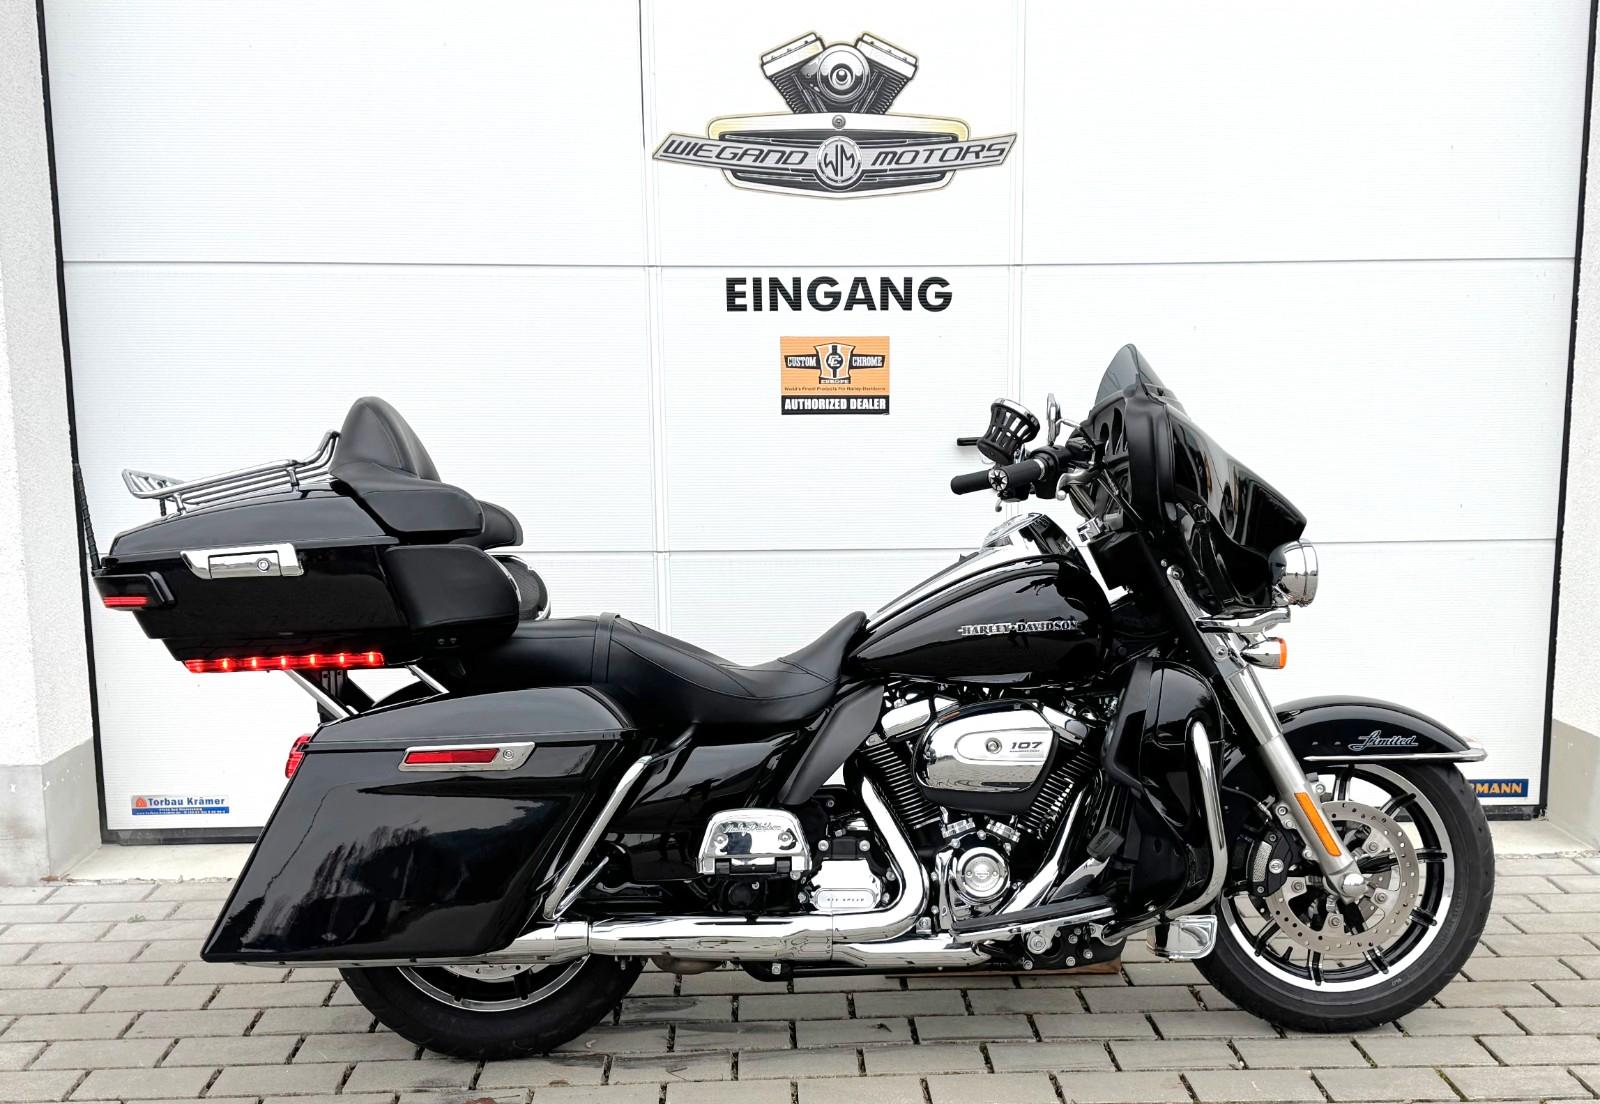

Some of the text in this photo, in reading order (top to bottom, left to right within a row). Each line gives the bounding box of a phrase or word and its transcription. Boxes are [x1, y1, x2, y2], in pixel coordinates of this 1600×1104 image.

[663, 139, 809, 166] WIEGAND
[871, 141, 1006, 167] MOTORS
[726, 276, 953, 312] EINGANG
[787, 356, 816, 367] CUSTOM
[852, 356, 883, 367] CHROME
[784, 398, 886, 410] AUTHORIZED DEALER
[1348, 730, 1419, 751] Limited
[1472, 782, 1523, 794] MANN
[148, 797, 225, 806] Torbau Krämer
